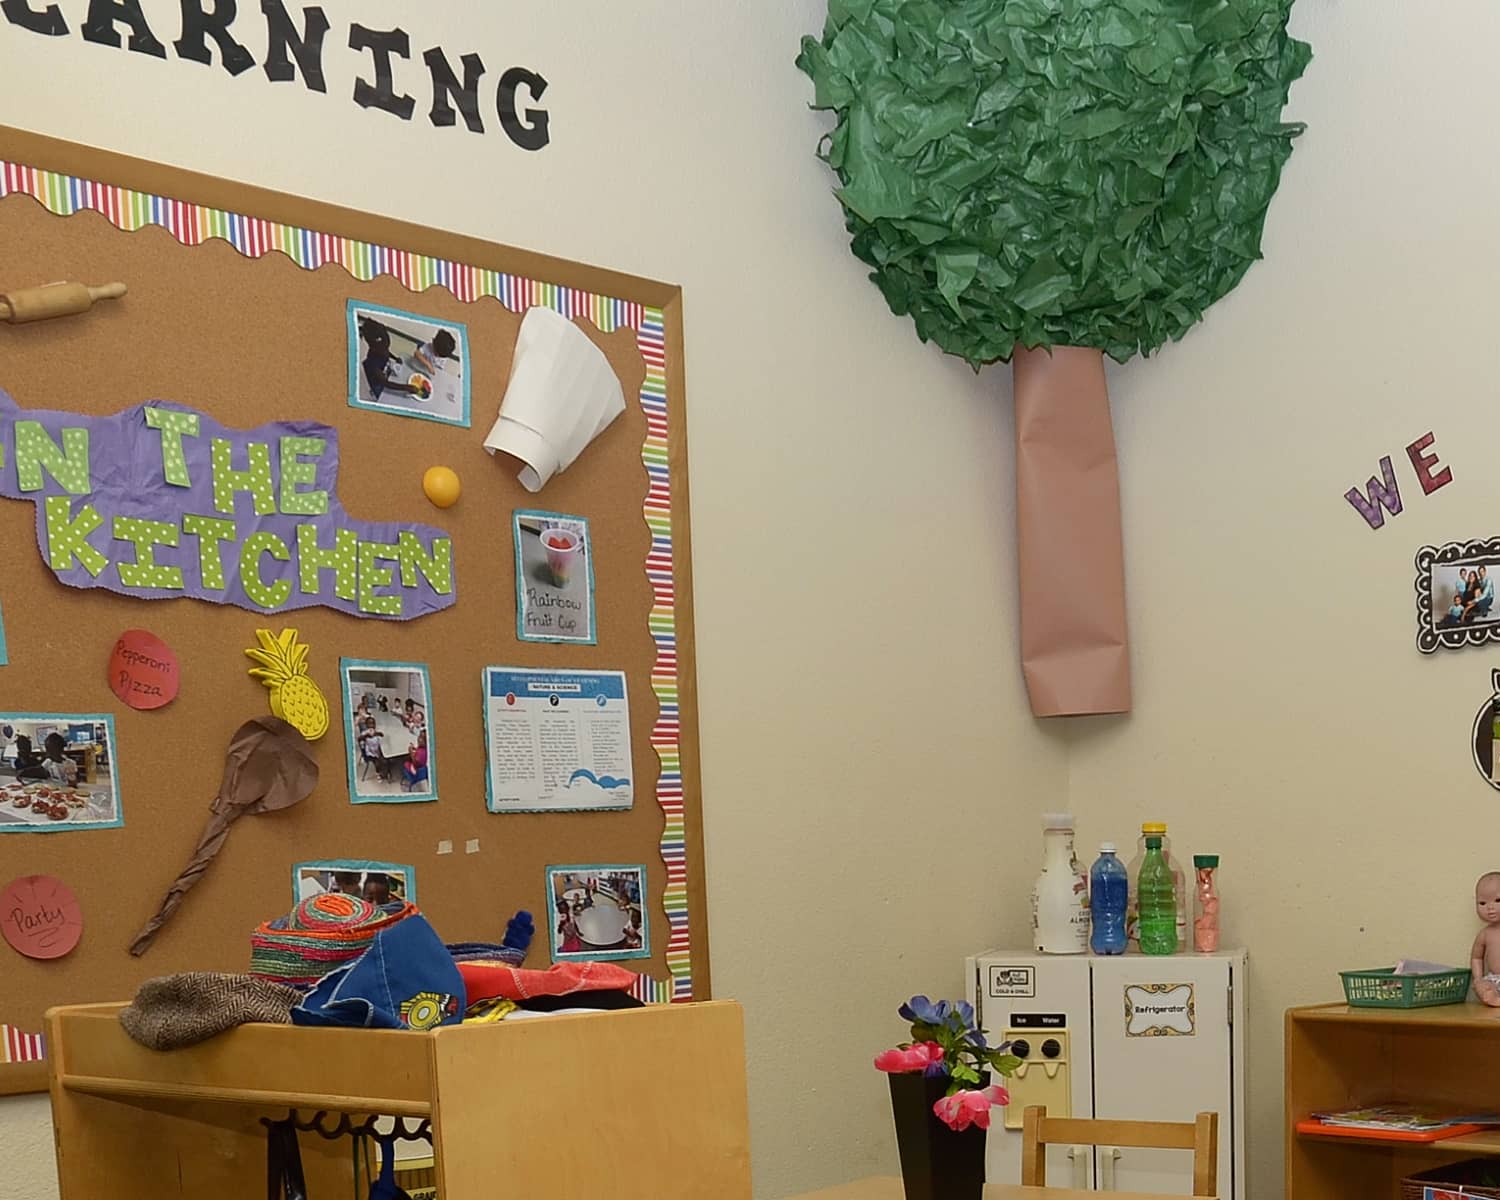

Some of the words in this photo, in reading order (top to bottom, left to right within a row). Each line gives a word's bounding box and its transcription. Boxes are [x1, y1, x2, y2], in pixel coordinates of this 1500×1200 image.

[0, 421, 91, 494] N
[144, 406, 329, 514] THE
[1344, 431, 1453, 530] WE
[46, 497, 452, 615] KITCHEN
[527, 587, 581, 610] Rainbow
[527, 611, 552, 627] Fruit
[558, 614, 576, 632] Cup
[116, 639, 171, 673] Pepperoni
[119, 670, 163, 697] Pizza
[10, 904, 65, 933] Party
[1134, 1004, 1186, 1015] Refrigerator
